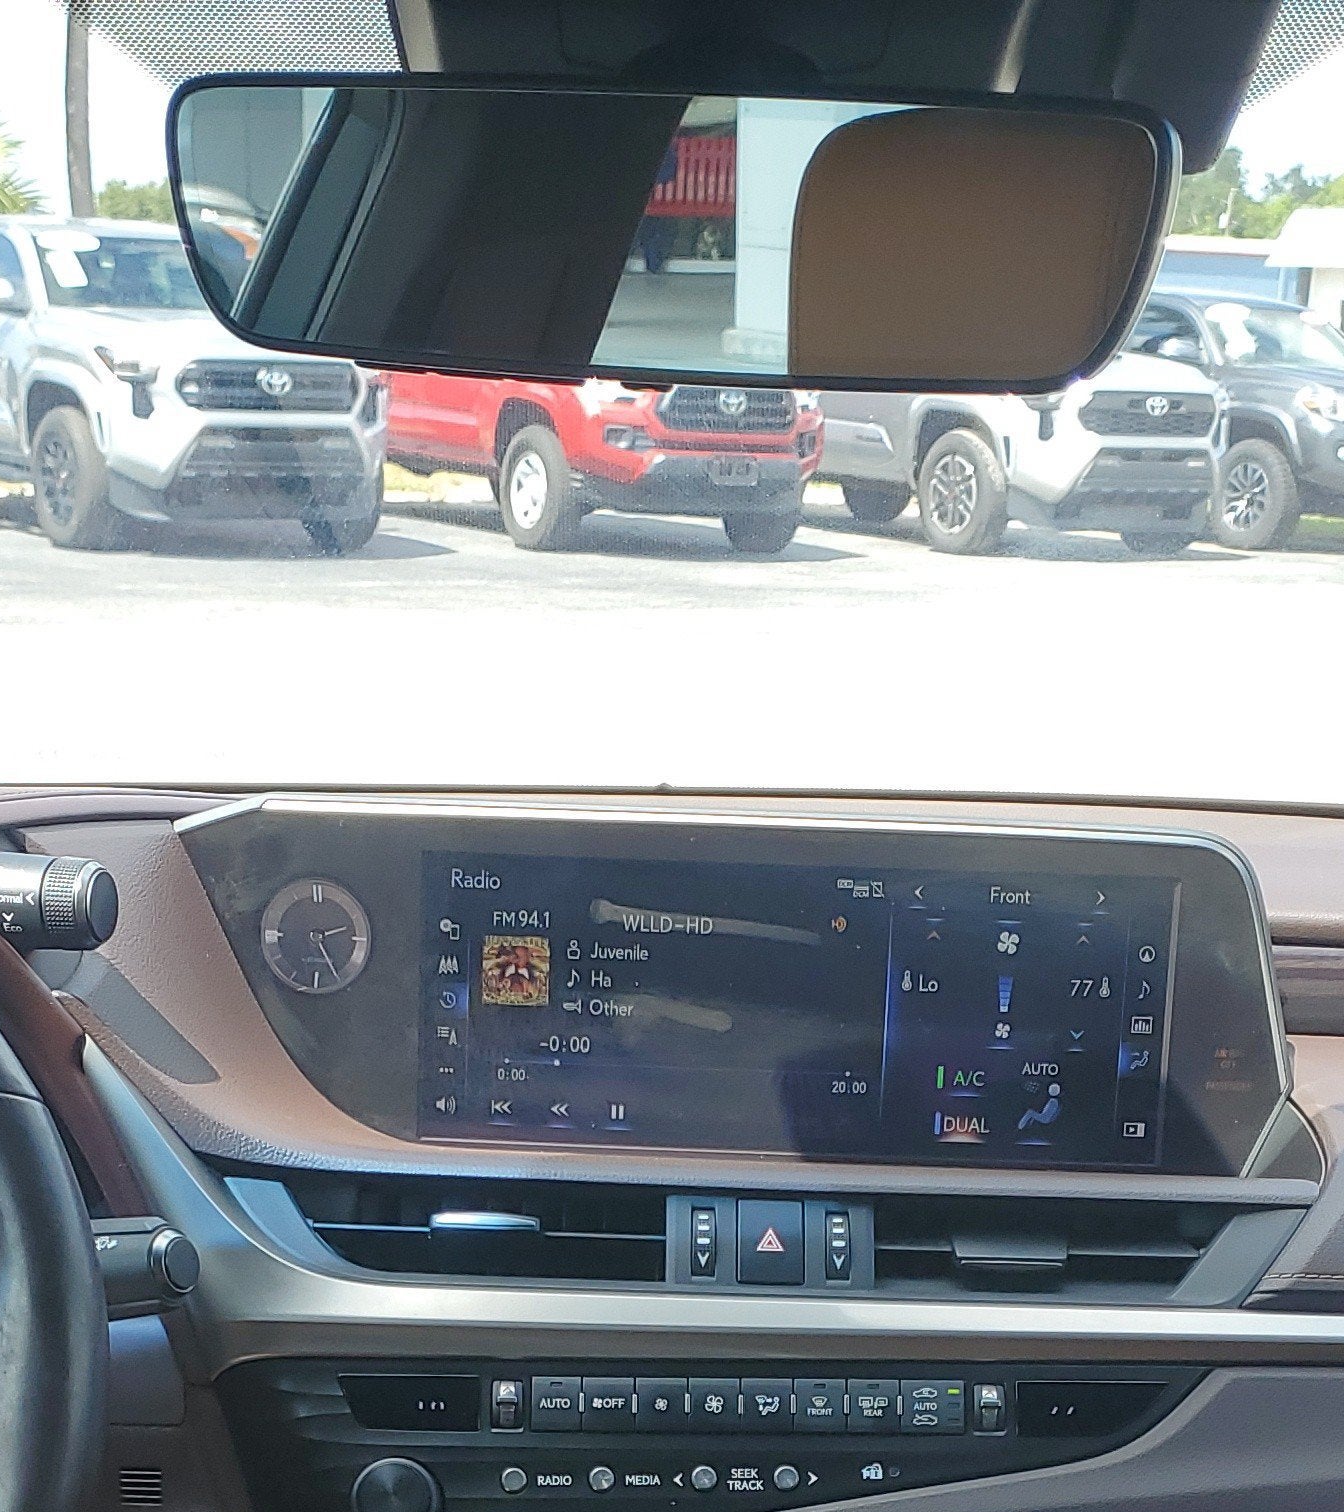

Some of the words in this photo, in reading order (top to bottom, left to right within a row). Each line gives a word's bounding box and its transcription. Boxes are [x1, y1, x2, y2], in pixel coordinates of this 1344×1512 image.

[451, 868, 501, 890] Radio
[990, 886, 1031, 905] Front
[3, 923, 23, 933] Eco
[623, 914, 713, 935] WLLD-HD
[590, 942, 649, 961] Juvenile
[591, 970, 612, 988] Ha
[918, 975, 939, 993] Lo
[1070, 979, 1094, 997] 77
[589, 1000, 634, 1017] Other
[1022, 1062, 1059, 1076] AUTO
[953, 1070, 985, 1087] A/C
[942, 1116, 990, 1134] DUAL
[539, 1398, 571, 1409] AUTO
[602, 1398, 626, 1409] OFF
[913, 1402, 938, 1411] AUTO
[807, 1407, 834, 1416] FRONT
[863, 1408, 883, 1417] REAR
[625, 1474, 661, 1487] MEDIA
[731, 1468, 759, 1479] SEEK
[537, 1475, 572, 1487] RADIO
[726, 1479, 764, 1491] TRACK
